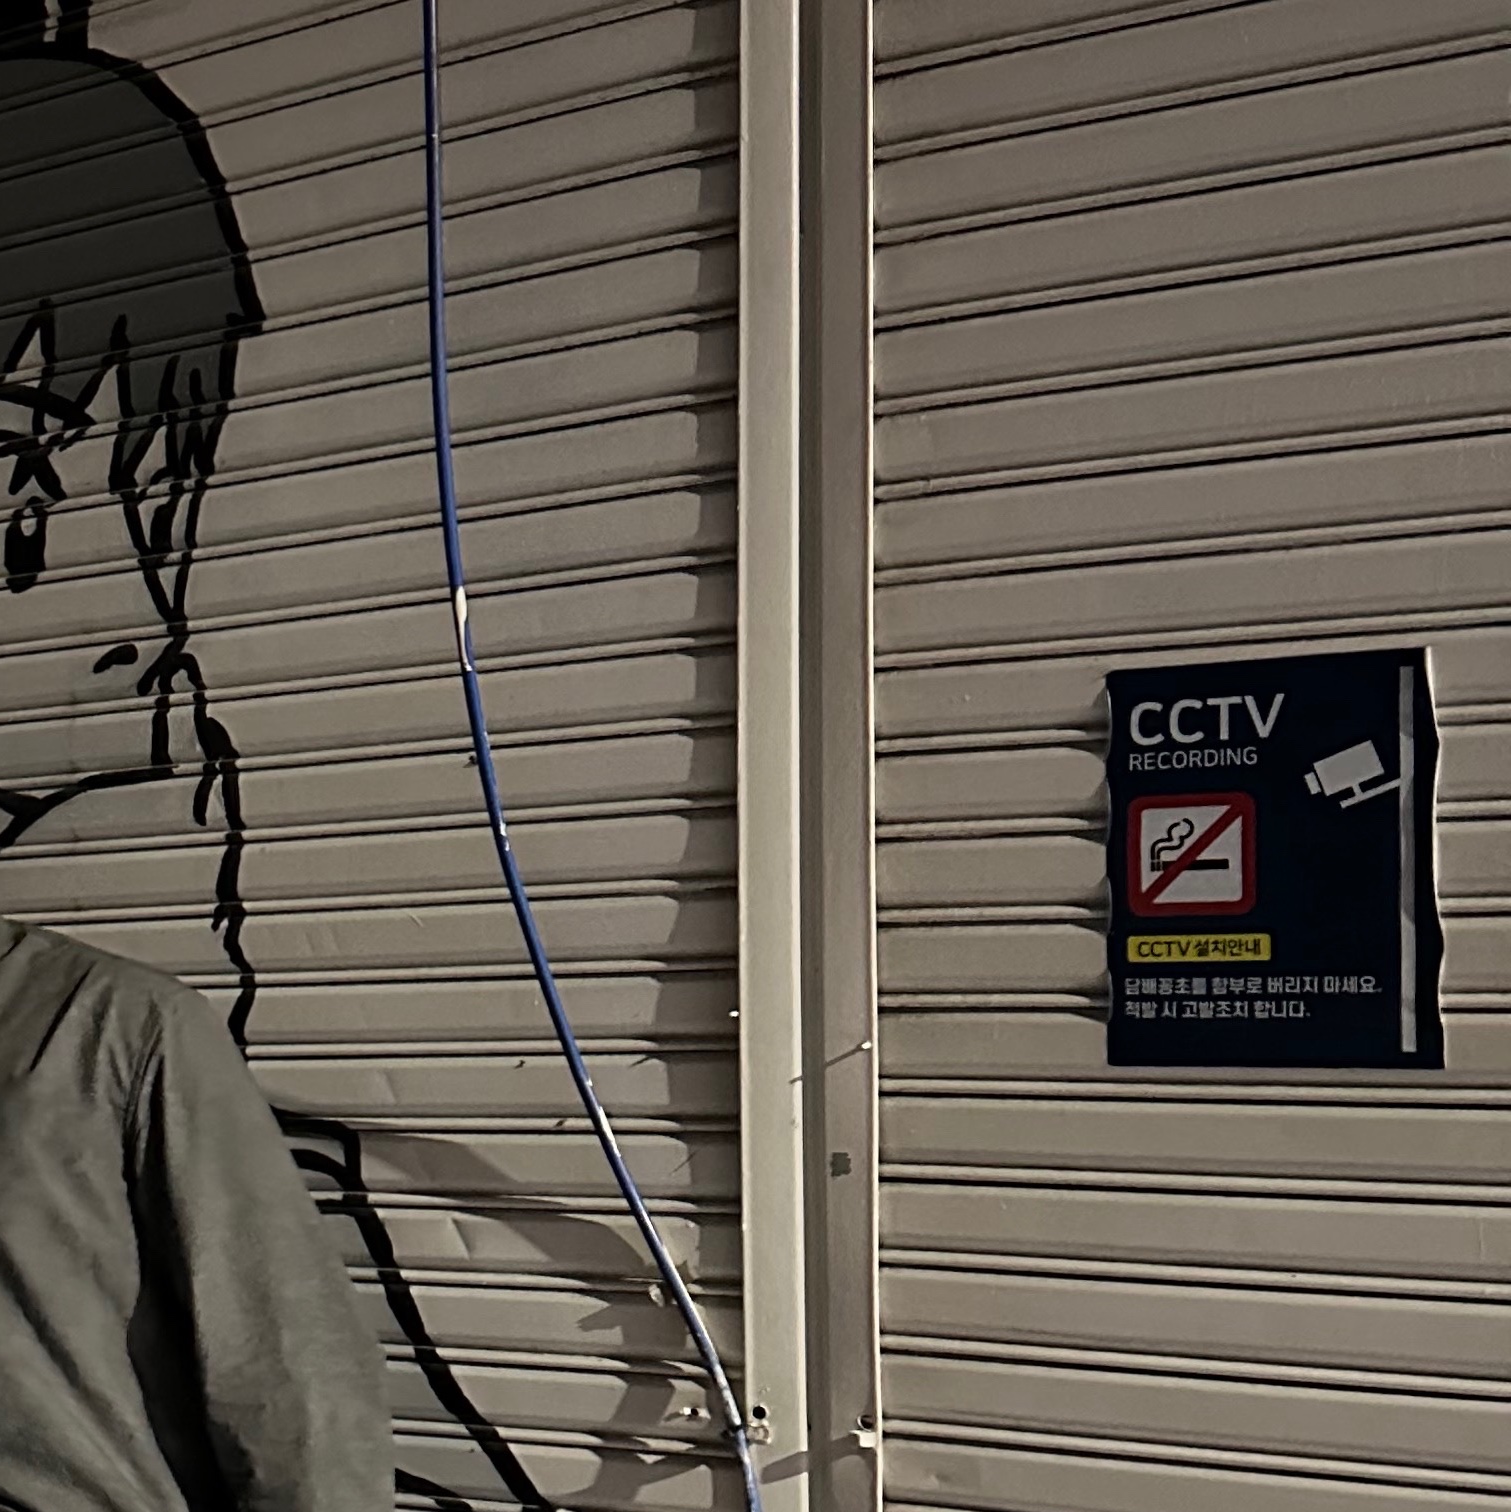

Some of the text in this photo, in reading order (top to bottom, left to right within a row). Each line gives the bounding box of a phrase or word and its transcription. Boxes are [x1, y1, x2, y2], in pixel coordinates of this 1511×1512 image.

[1129, 693, 1286, 746] CCTV
[1128, 746, 1259, 771] RECORDING
[1124, 975, 1383, 996] 담배꽁초 함부로 버리지 마세요.
[1124, 1000, 1311, 1019] 적발 시 고발조치 합니다.
